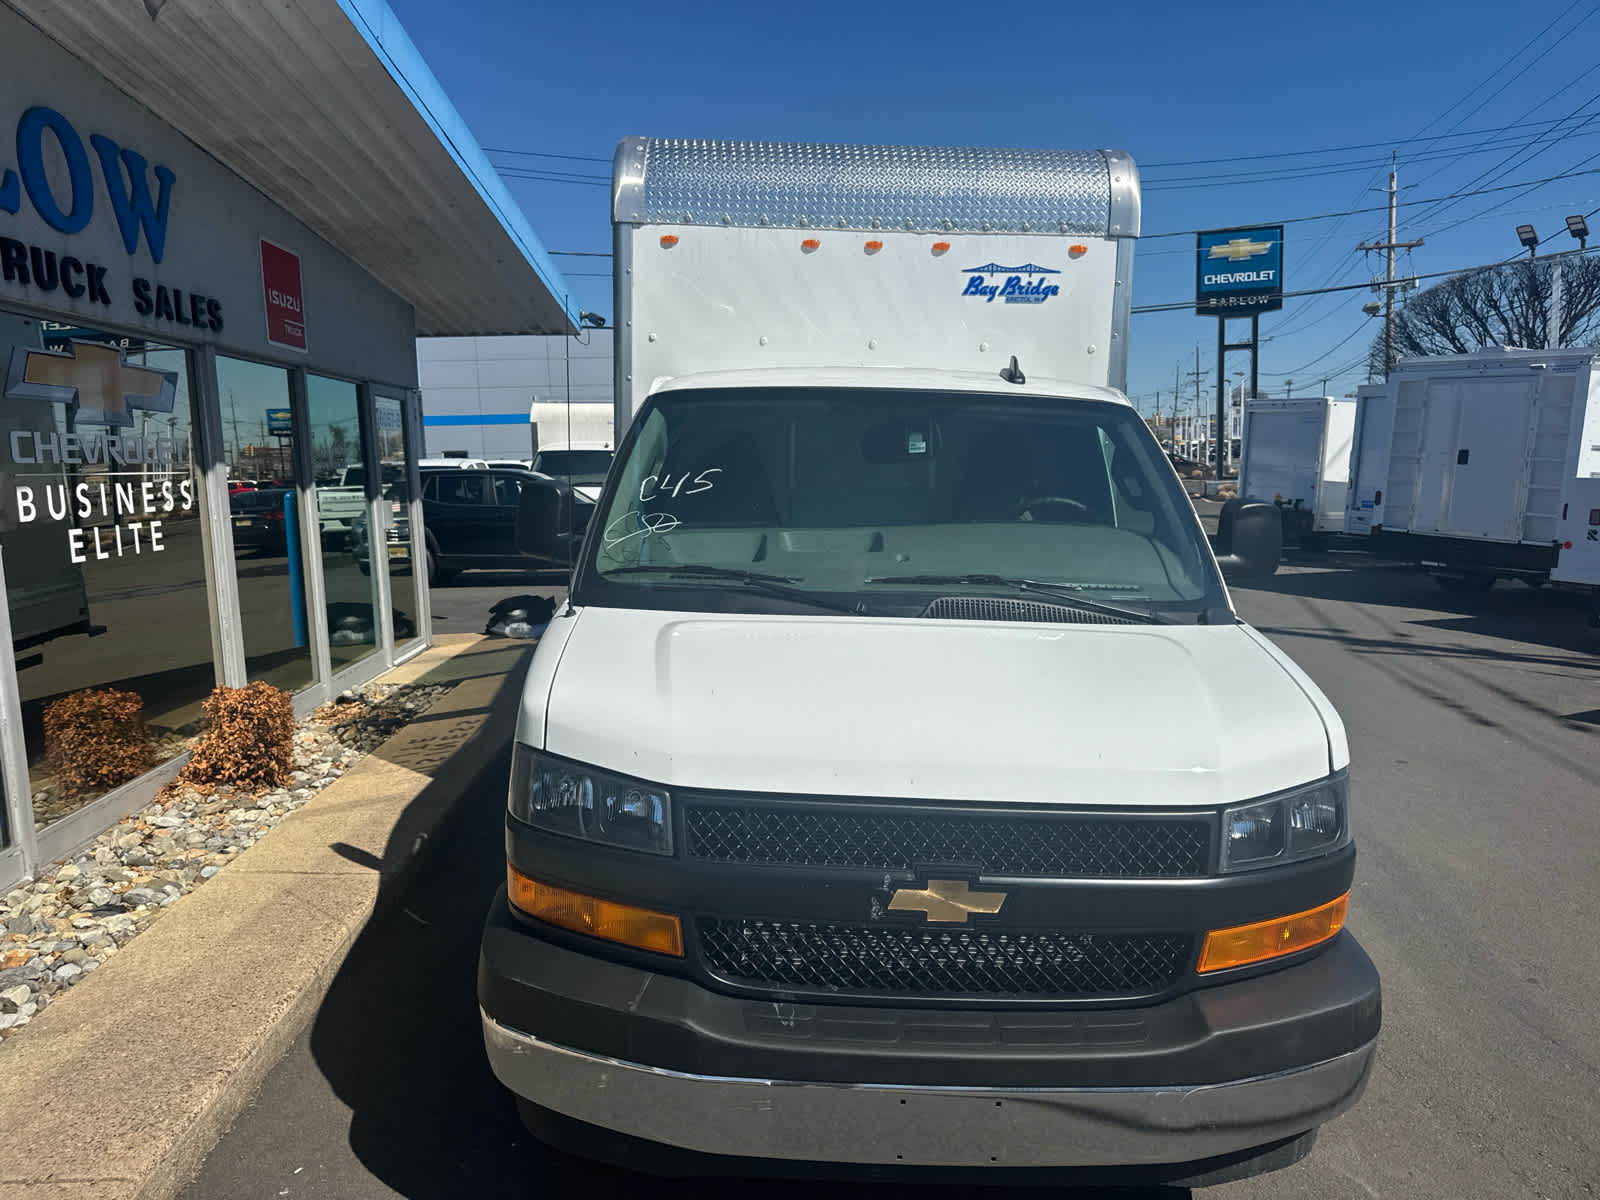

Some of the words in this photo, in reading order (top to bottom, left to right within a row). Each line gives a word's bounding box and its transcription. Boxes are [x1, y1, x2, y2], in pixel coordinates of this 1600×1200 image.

[961, 275, 999, 303] Bay
[997, 275, 1060, 304] Bridge
[1204, 269, 1276, 285] CHEVROLET
[132, 277, 224, 332] SALES
[268, 288, 301, 313] ISUZU
[15, 479, 193, 523] BUSINESS
[67, 520, 165, 563] ELITE
